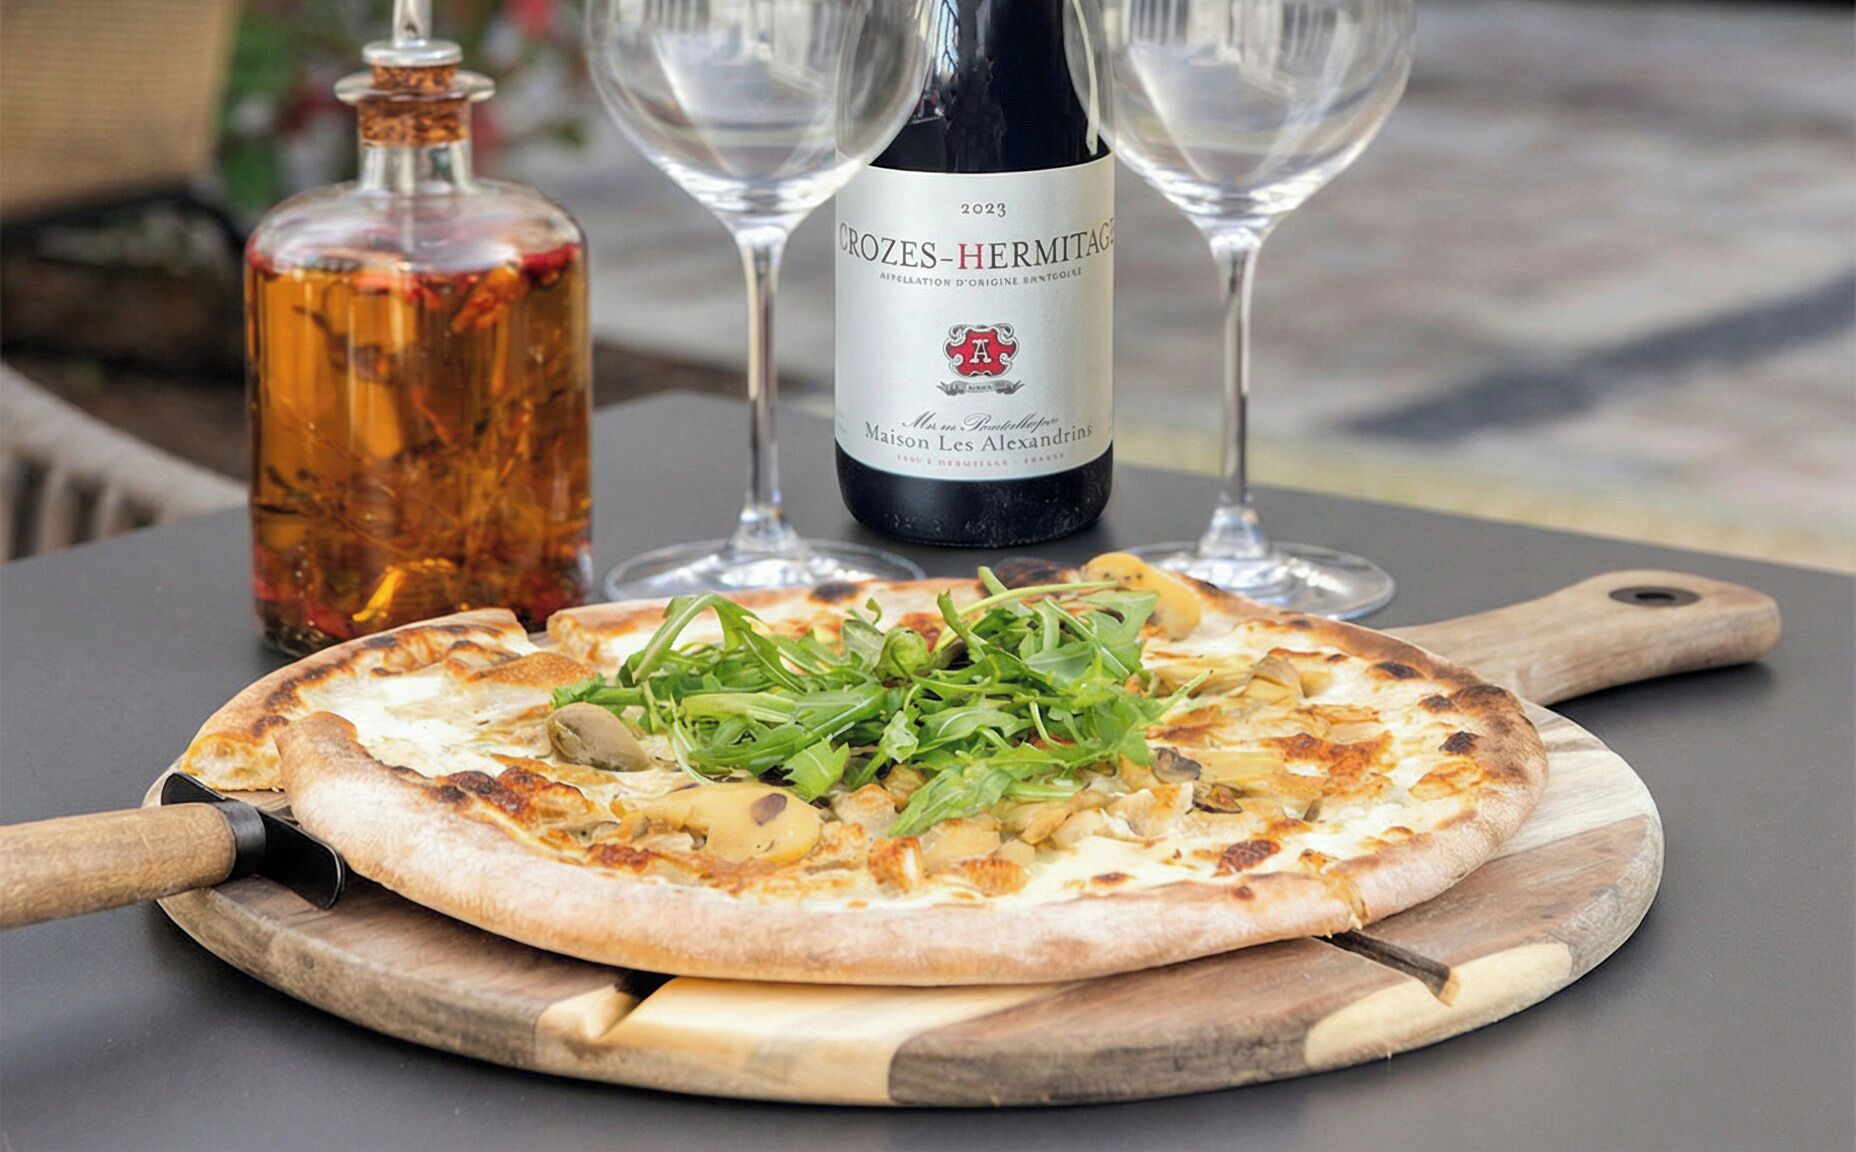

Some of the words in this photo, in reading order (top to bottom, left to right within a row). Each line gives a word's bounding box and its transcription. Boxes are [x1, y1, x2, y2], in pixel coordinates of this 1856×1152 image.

[961, 203, 1007, 218] 2023
[969, 339, 992, 364] A
[865, 421, 930, 450] Maison
[939, 435, 974, 452] Les
[981, 424, 1092, 452] Alexandrins
